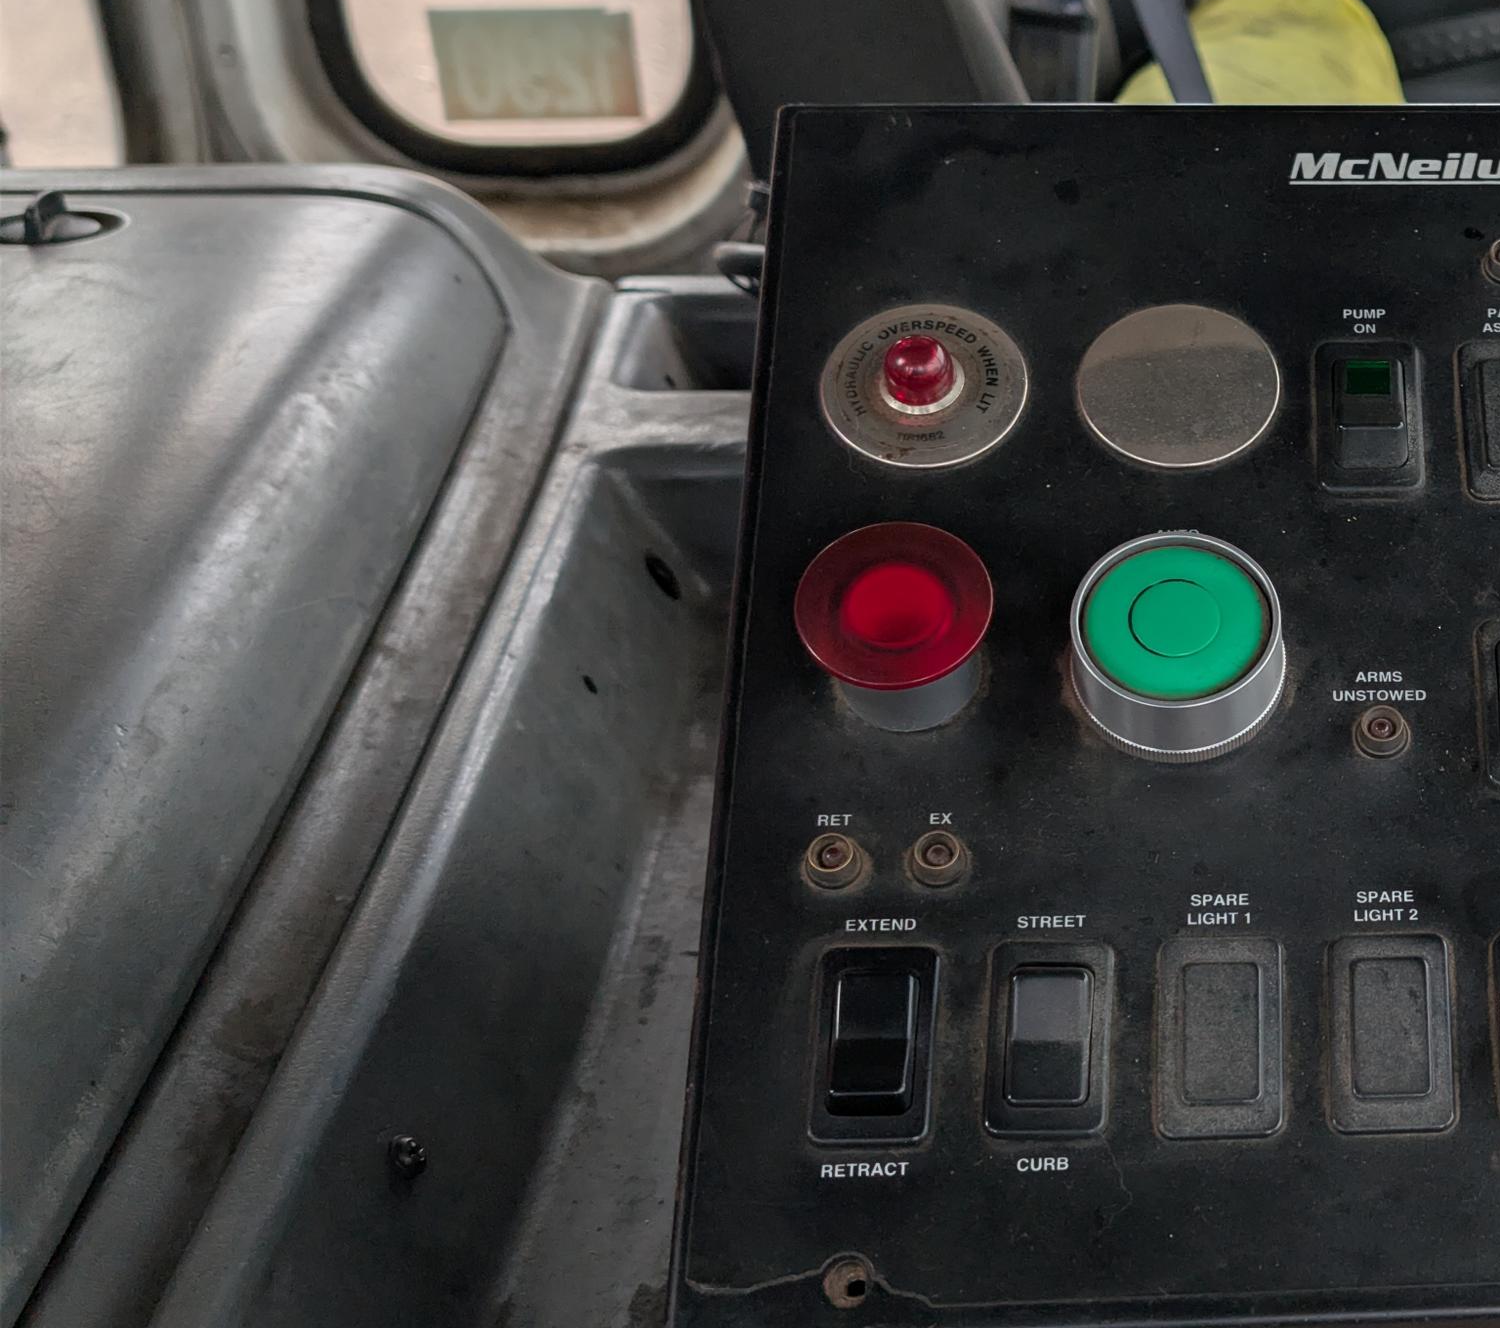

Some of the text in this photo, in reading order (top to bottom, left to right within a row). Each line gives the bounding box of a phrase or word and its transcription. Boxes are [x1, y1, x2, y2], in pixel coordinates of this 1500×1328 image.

[1342, 308, 1386, 320] PUMP
[878, 320, 976, 344] OVERSPEED
[1353, 323, 1376, 334] ON
[977, 345, 999, 387] WHEN
[976, 393, 996, 414] LIT
[1355, 670, 1403, 683] ARMS
[1332, 689, 1427, 702] UNSTOWED
[817, 813, 853, 827] RET
[929, 812, 953, 825] EX
[1190, 893, 1250, 907] SPARE
[1356, 890, 1415, 904] SPARE
[1017, 914, 1087, 929] STREET
[1187, 911, 1251, 926] LIGHT 1
[1353, 908, 1419, 922] LIGHT 2
[845, 918, 917, 932] EXTEND
[820, 1161, 910, 1178] RETRACT
[1016, 1156, 1069, 1172] CURB
